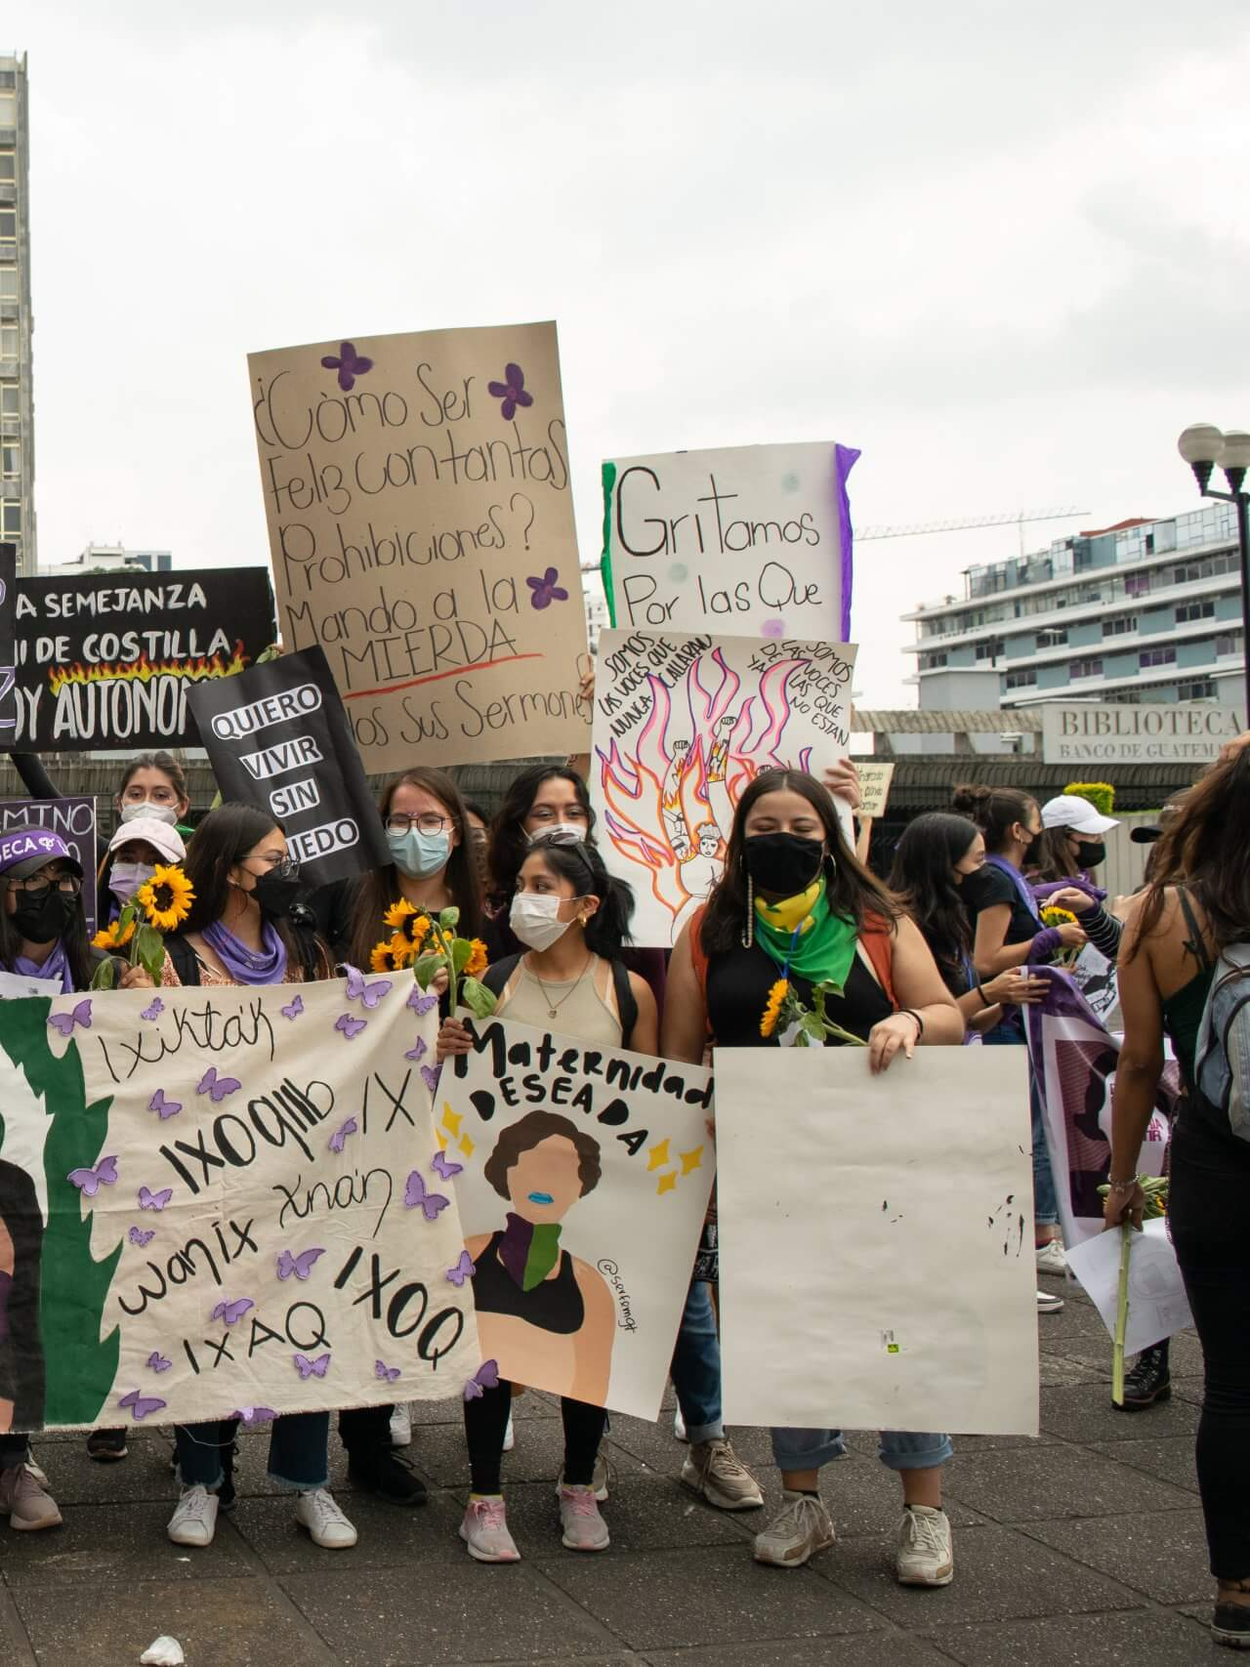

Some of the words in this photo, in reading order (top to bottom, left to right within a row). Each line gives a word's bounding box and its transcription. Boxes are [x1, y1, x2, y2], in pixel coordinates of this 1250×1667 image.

[417, 363, 476, 427] Ser
[616, 466, 821, 556] Gritamos
[15, 594, 38, 619] A
[44, 582, 207, 618] SEMEJANZA
[285, 585, 417, 653] Mando
[432, 587, 458, 621] a
[480, 569, 519, 615] la
[623, 575, 680, 628] Por
[697, 575, 751, 615] las
[36, 636, 70, 663] DE
[83, 628, 231, 664] COSTILLA
[341, 617, 519, 690] MIERDA
[604, 631, 655, 682] SOMOS
[806, 641, 853, 683] SOMOS
[598, 692, 623, 716] LAS
[614, 661, 650, 696] VOCES
[647, 637, 677, 667] QUE
[760, 642, 783, 662] DE
[789, 674, 812, 697] LAS
[814, 696, 843, 718] QUE
[804, 663, 841, 698] VOCES
[214, 686, 320, 738] QUIERO
[401, 696, 448, 743] Sus
[610, 695, 653, 738] NUNCA
[790, 696, 810, 714] NO
[811, 713, 849, 746] ESTAN
[1060, 710, 1242, 736] BIBLIOTECA
[244, 739, 320, 780] VIVIR
[1059, 744, 1116, 759] BANCO
[1120, 743, 1143, 758] DE
[1146, 742, 1222, 758] GUATEM
[272, 781, 317, 816] SIN
[453, 1016, 715, 1110] Maternidad
[362, 1068, 415, 1134] IX
[469, 1074, 648, 1156] DESEADA
[334, 1246, 464, 1372] IXOQ
[183, 1301, 332, 1375] IXAQ
